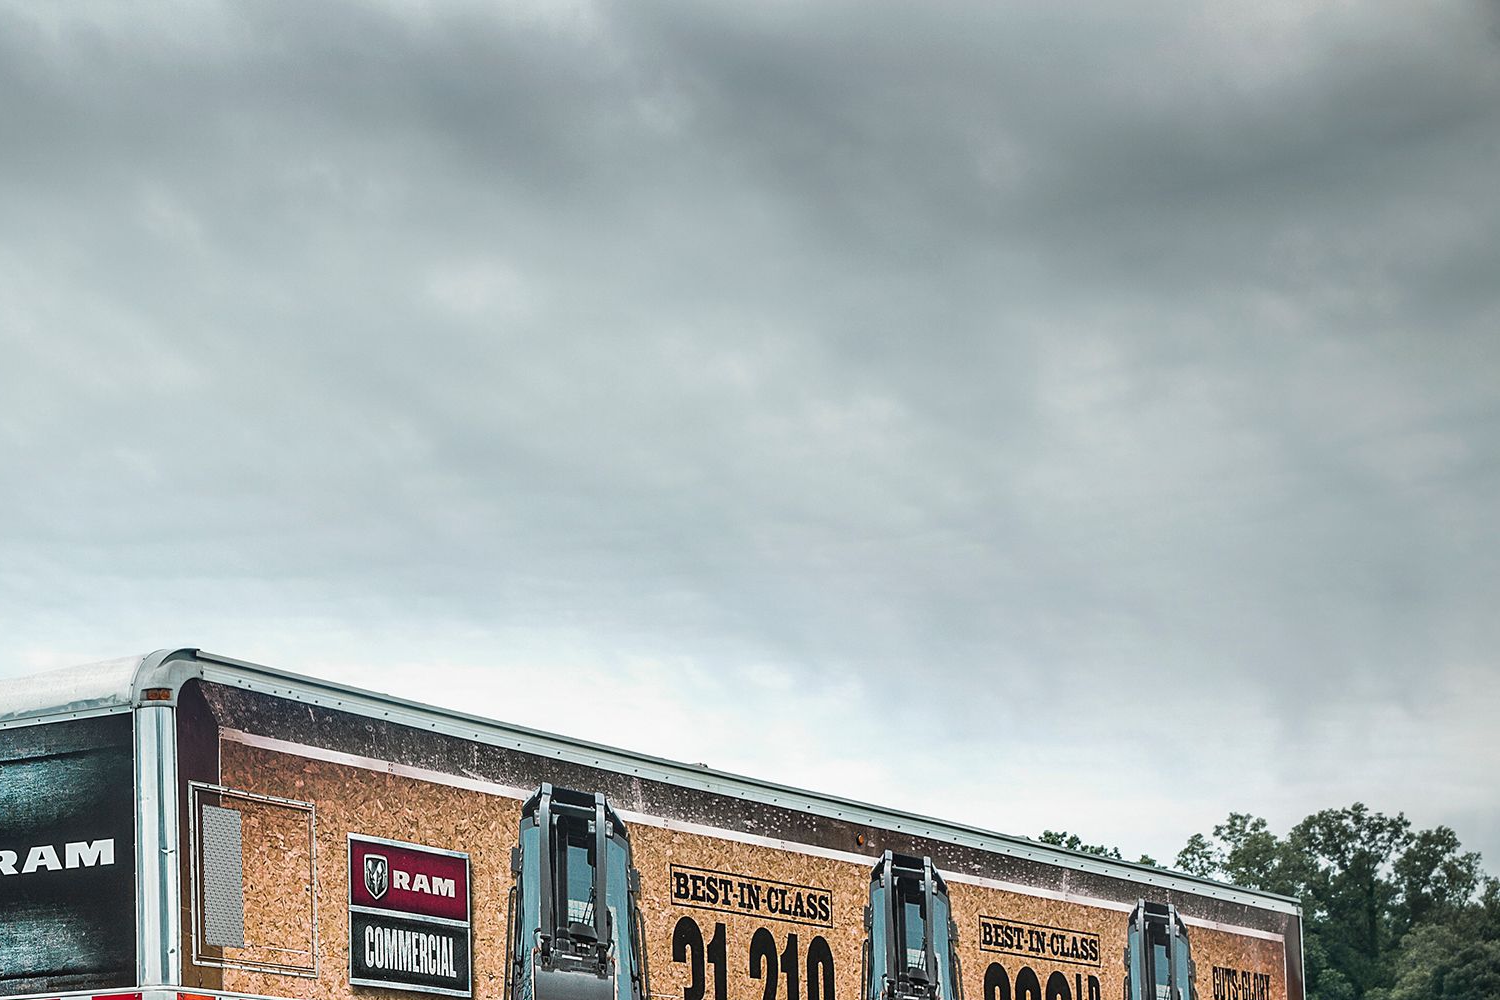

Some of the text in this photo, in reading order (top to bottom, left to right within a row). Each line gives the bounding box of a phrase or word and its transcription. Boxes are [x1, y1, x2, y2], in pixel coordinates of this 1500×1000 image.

[392, 869, 456, 898] RAM
[673, 871, 830, 922] BEST-IN-CLASS
[364, 925, 458, 979] COMMERCIAL
[981, 921, 1099, 962] BEST-IN-CLASS
